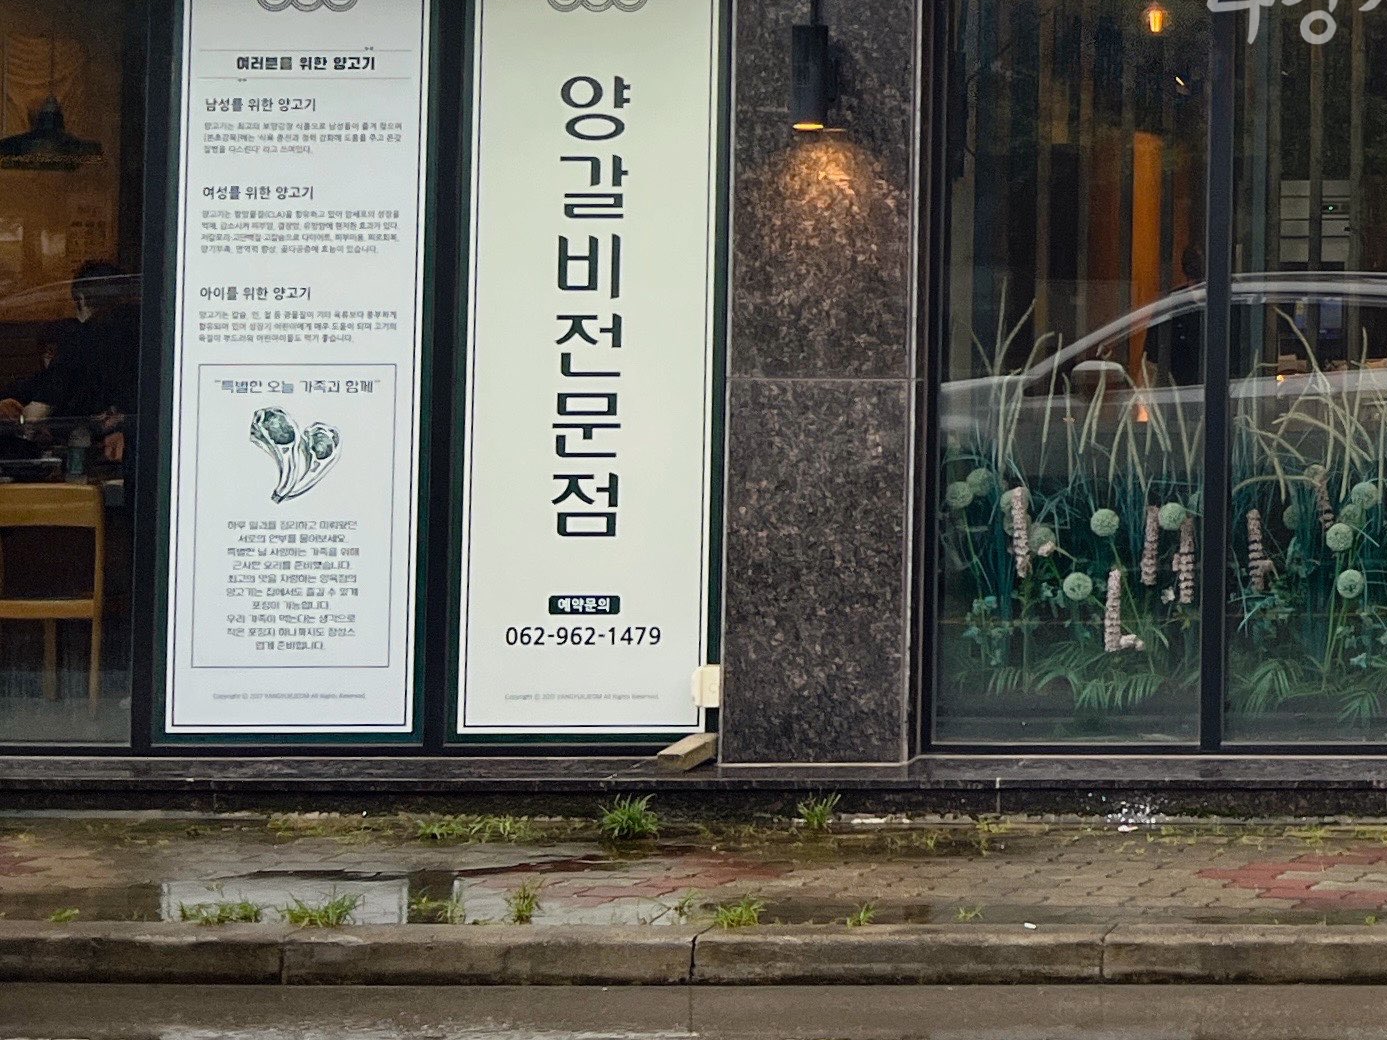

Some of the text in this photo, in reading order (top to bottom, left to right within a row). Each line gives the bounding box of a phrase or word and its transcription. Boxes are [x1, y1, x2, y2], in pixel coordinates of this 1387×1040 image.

[299, 56, 328, 71] 위한
[333, 56, 375, 71] 양고기
[248, 98, 274, 112] 위한
[278, 98, 316, 112] 양고기
[245, 186, 271, 200] 위한
[275, 185, 314, 201] 양고기
[242, 286, 269, 301] 위한
[272, 286, 311, 301] 양고기
[550, 75, 631, 538] 양갈비전문점
[557, 596, 611, 613] 예약문의
[505, 626, 662, 646] 062-962-1479
